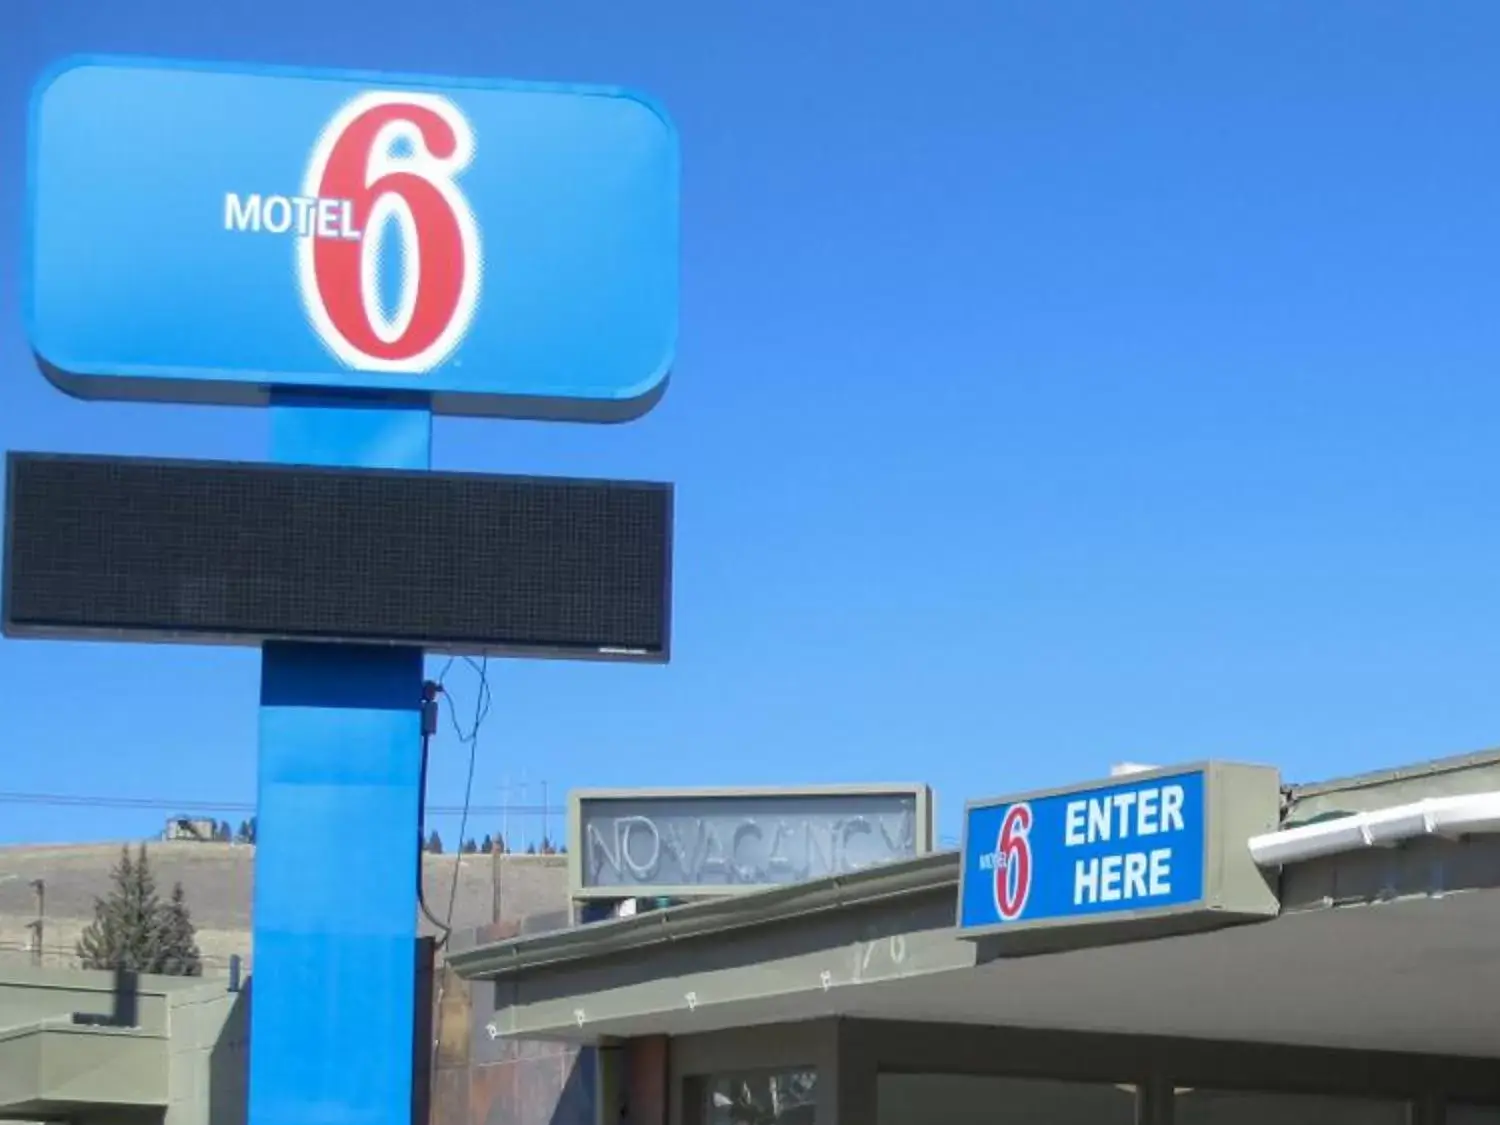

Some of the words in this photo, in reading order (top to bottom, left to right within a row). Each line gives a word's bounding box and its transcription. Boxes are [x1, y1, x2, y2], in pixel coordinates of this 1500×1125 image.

[224, 192, 361, 239] MOTEL
[303, 94, 475, 368] 6
[587, 815, 660, 879] NO
[1065, 784, 1185, 847] ENTER
[994, 804, 1032, 919] 6
[1074, 847, 1172, 906] HERE
